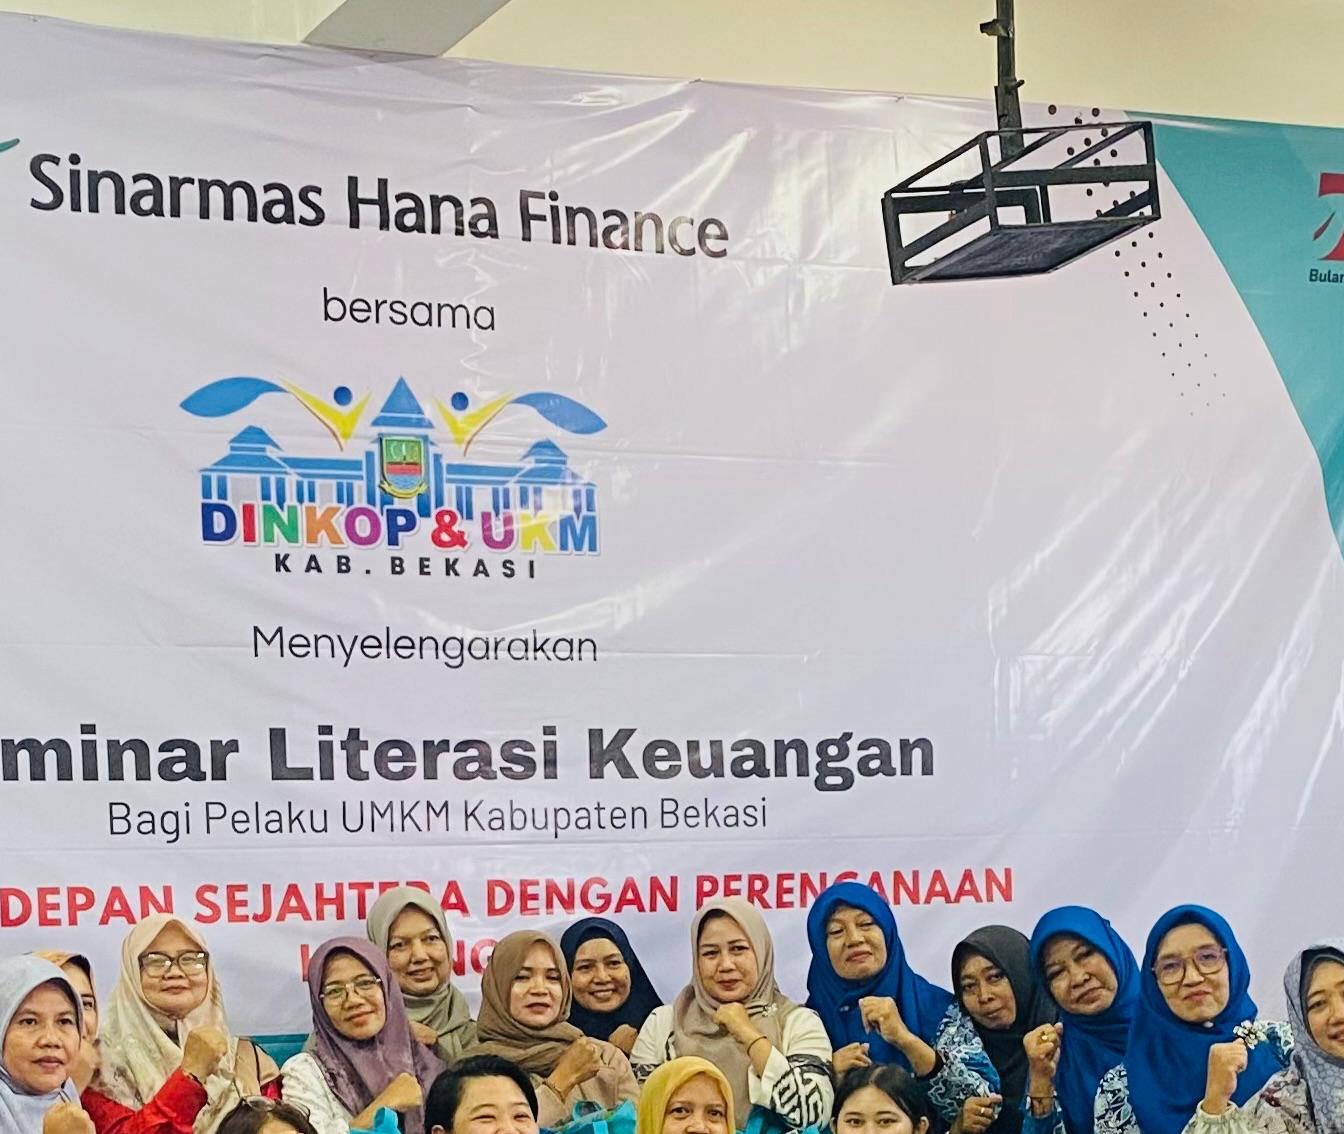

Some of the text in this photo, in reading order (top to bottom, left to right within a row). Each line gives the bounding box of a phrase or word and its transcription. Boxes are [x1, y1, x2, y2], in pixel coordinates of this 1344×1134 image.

[28, 152, 730, 258] Sinarmas Hana Finance
[321, 286, 496, 332] bersama
[201, 502, 599, 553] DINKOP & UKM
[390, 555, 536, 580] BEKASI
[252, 625, 598, 669] Menyelengarakan
[268, 724, 558, 782] Literasi
[587, 727, 934, 792] Keuangan
[108, 796, 768, 844] Bagi Pelaku UMKM Kabupaten Bekasi
[0, 885, 174, 928] DEPAN
[193, 879, 470, 925] SEJAHTA
[487, 875, 678, 918] DENGAN
